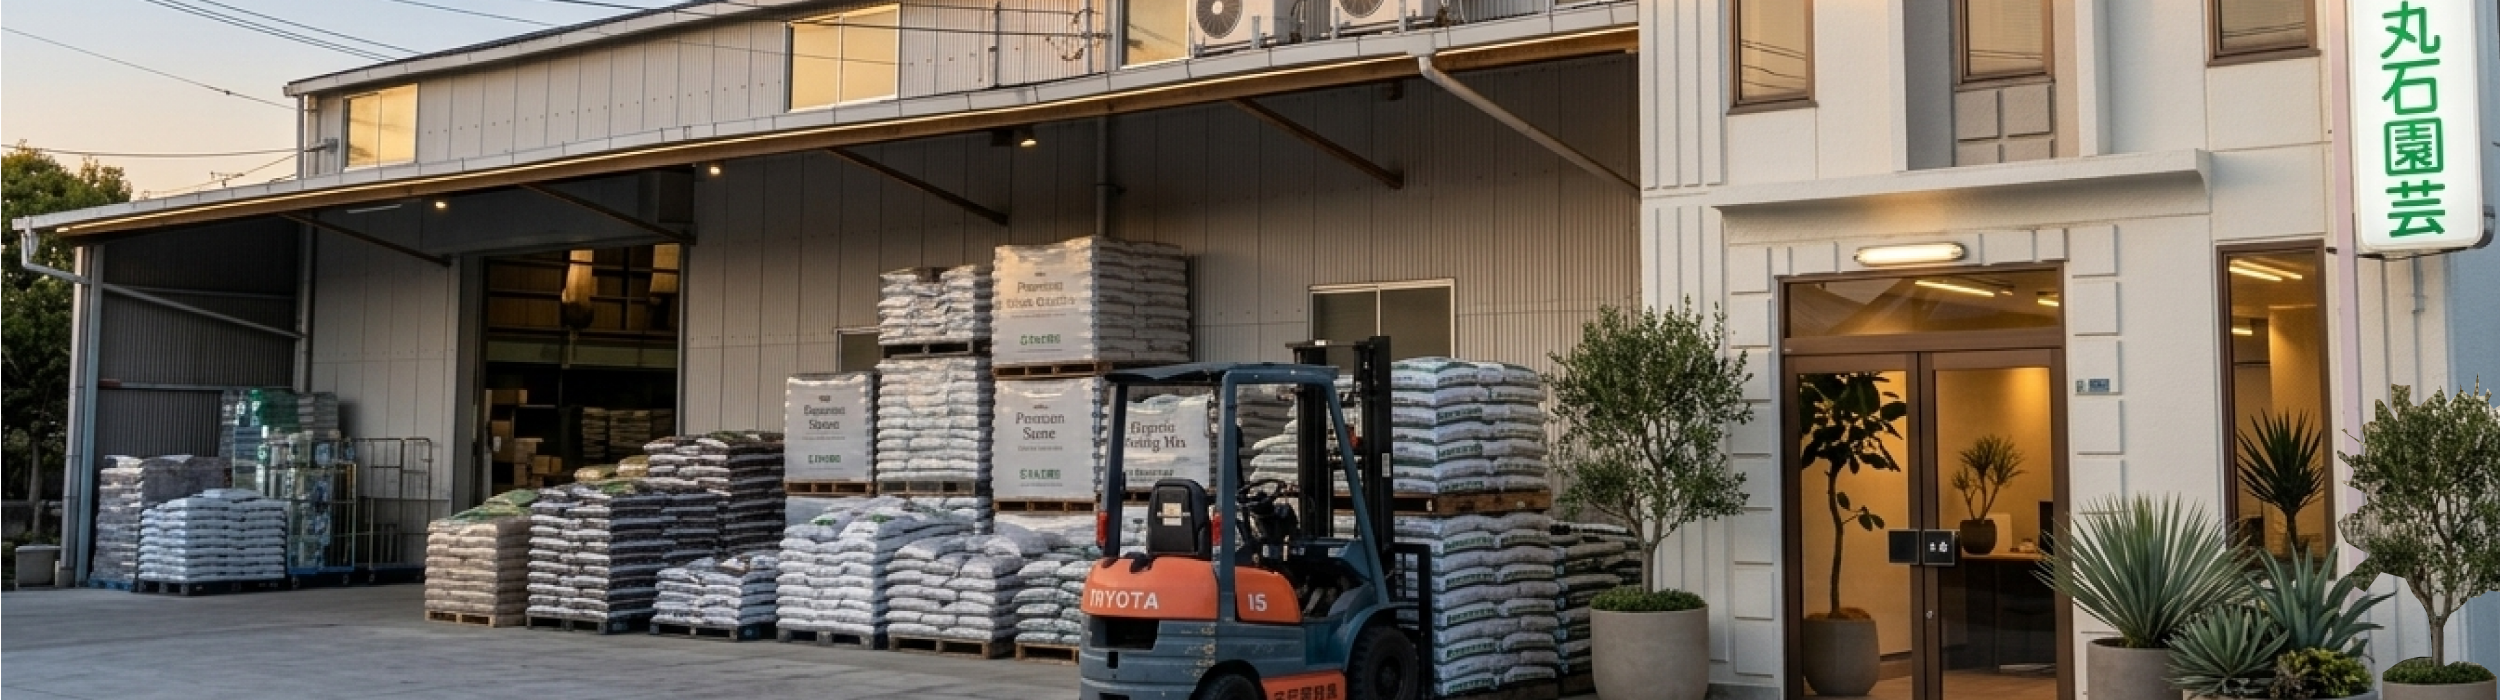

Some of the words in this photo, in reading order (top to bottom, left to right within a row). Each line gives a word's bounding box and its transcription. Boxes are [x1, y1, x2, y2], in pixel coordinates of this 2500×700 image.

[2380, 1, 2446, 238] 丸石園芸
[1247, 593, 1268, 612] 15
